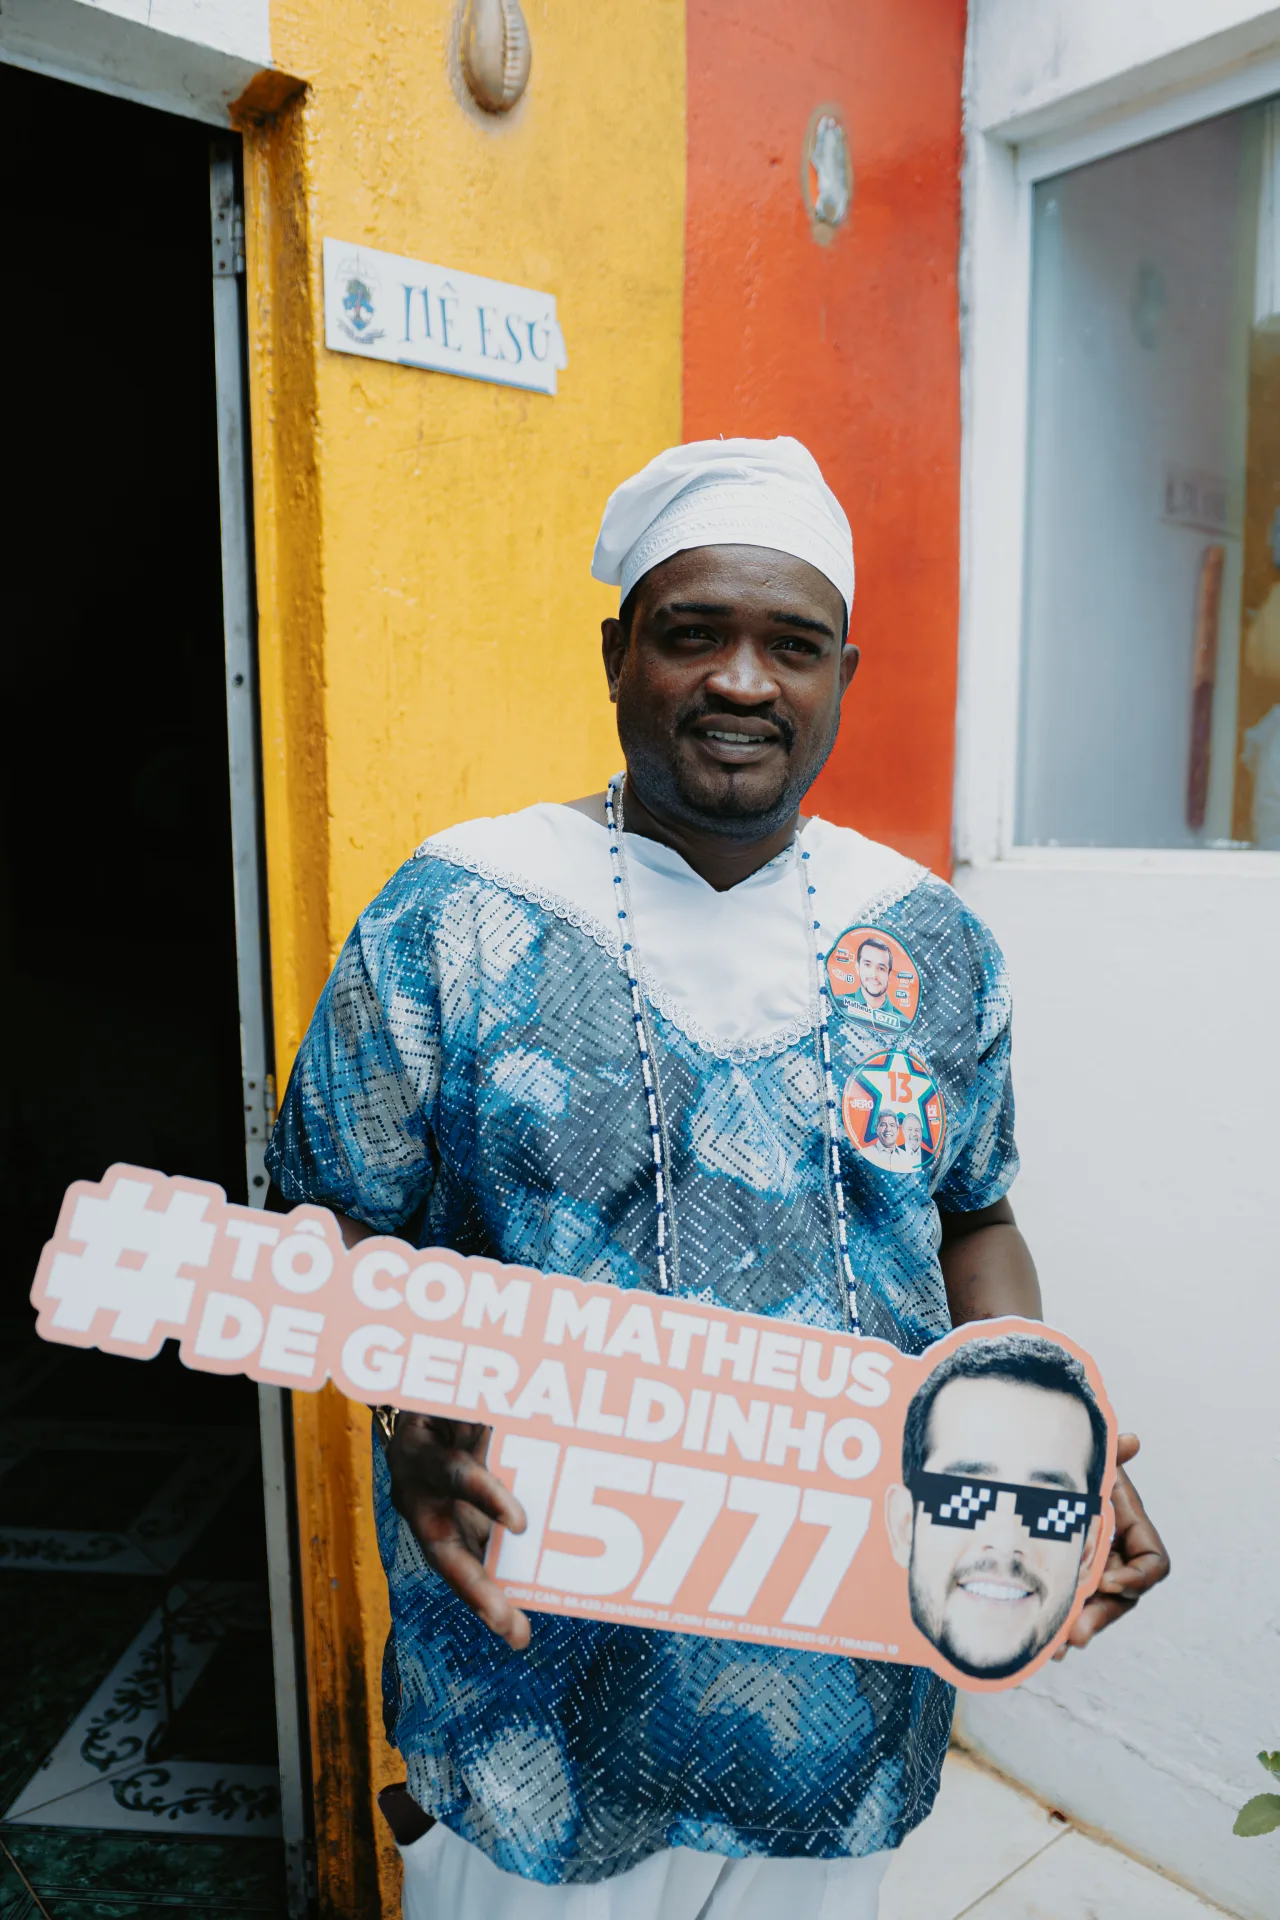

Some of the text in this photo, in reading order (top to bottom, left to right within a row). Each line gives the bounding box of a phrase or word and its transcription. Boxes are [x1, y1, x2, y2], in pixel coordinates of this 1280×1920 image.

[844, 998, 872, 1014] Matheus
[888, 1071, 912, 1104] 13
[193, 1290, 882, 1481] DE GERALDINHO
[351, 1250, 533, 1338] COM
[543, 1287, 894, 1408] MATHEUS
[495, 1433, 872, 1628] 15777
